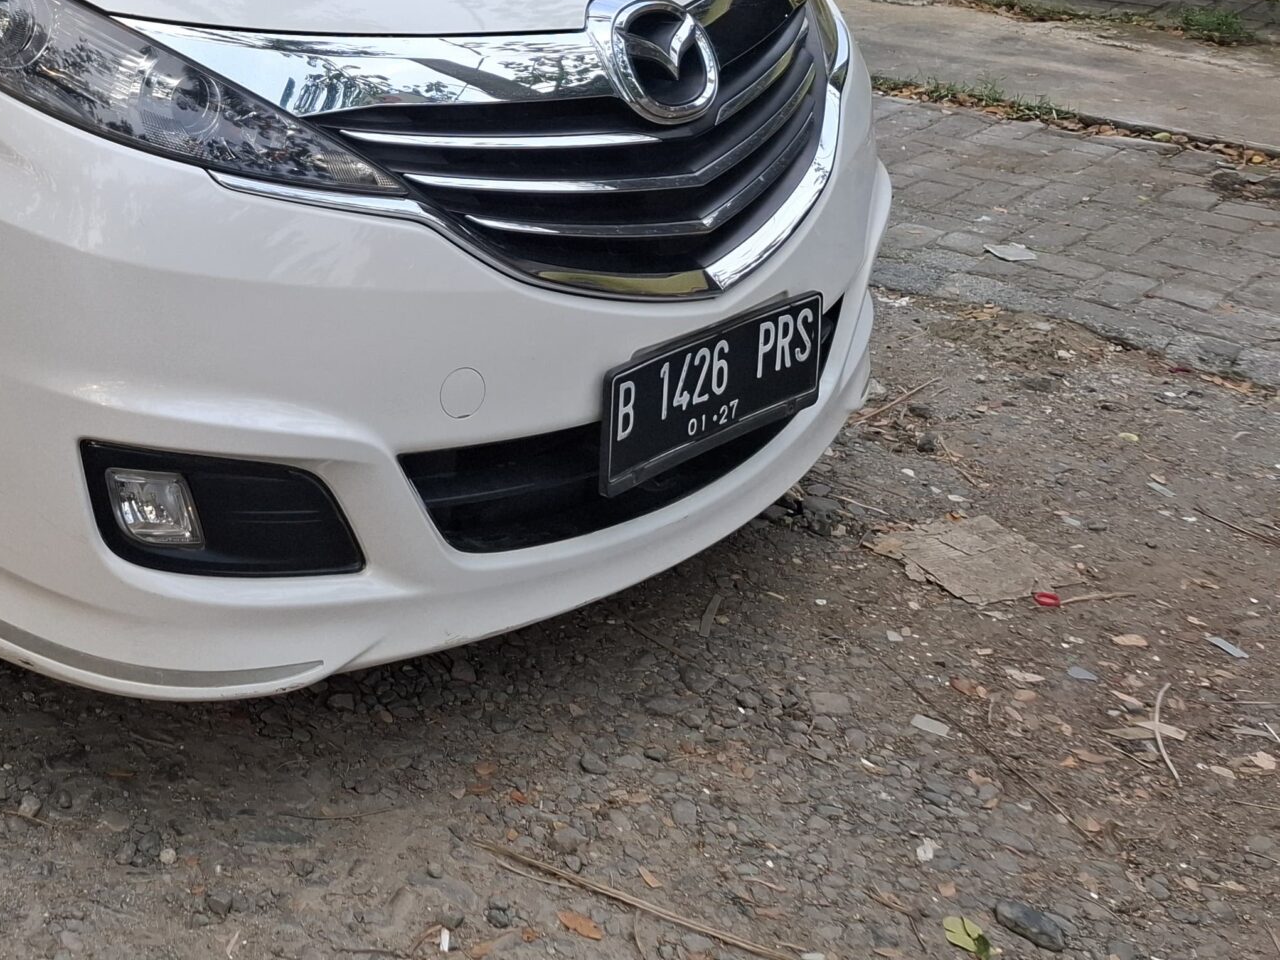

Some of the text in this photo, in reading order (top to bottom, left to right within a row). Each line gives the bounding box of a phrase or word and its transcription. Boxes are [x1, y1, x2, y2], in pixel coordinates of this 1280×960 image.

[617, 307, 814, 442] B 1426 PRS
